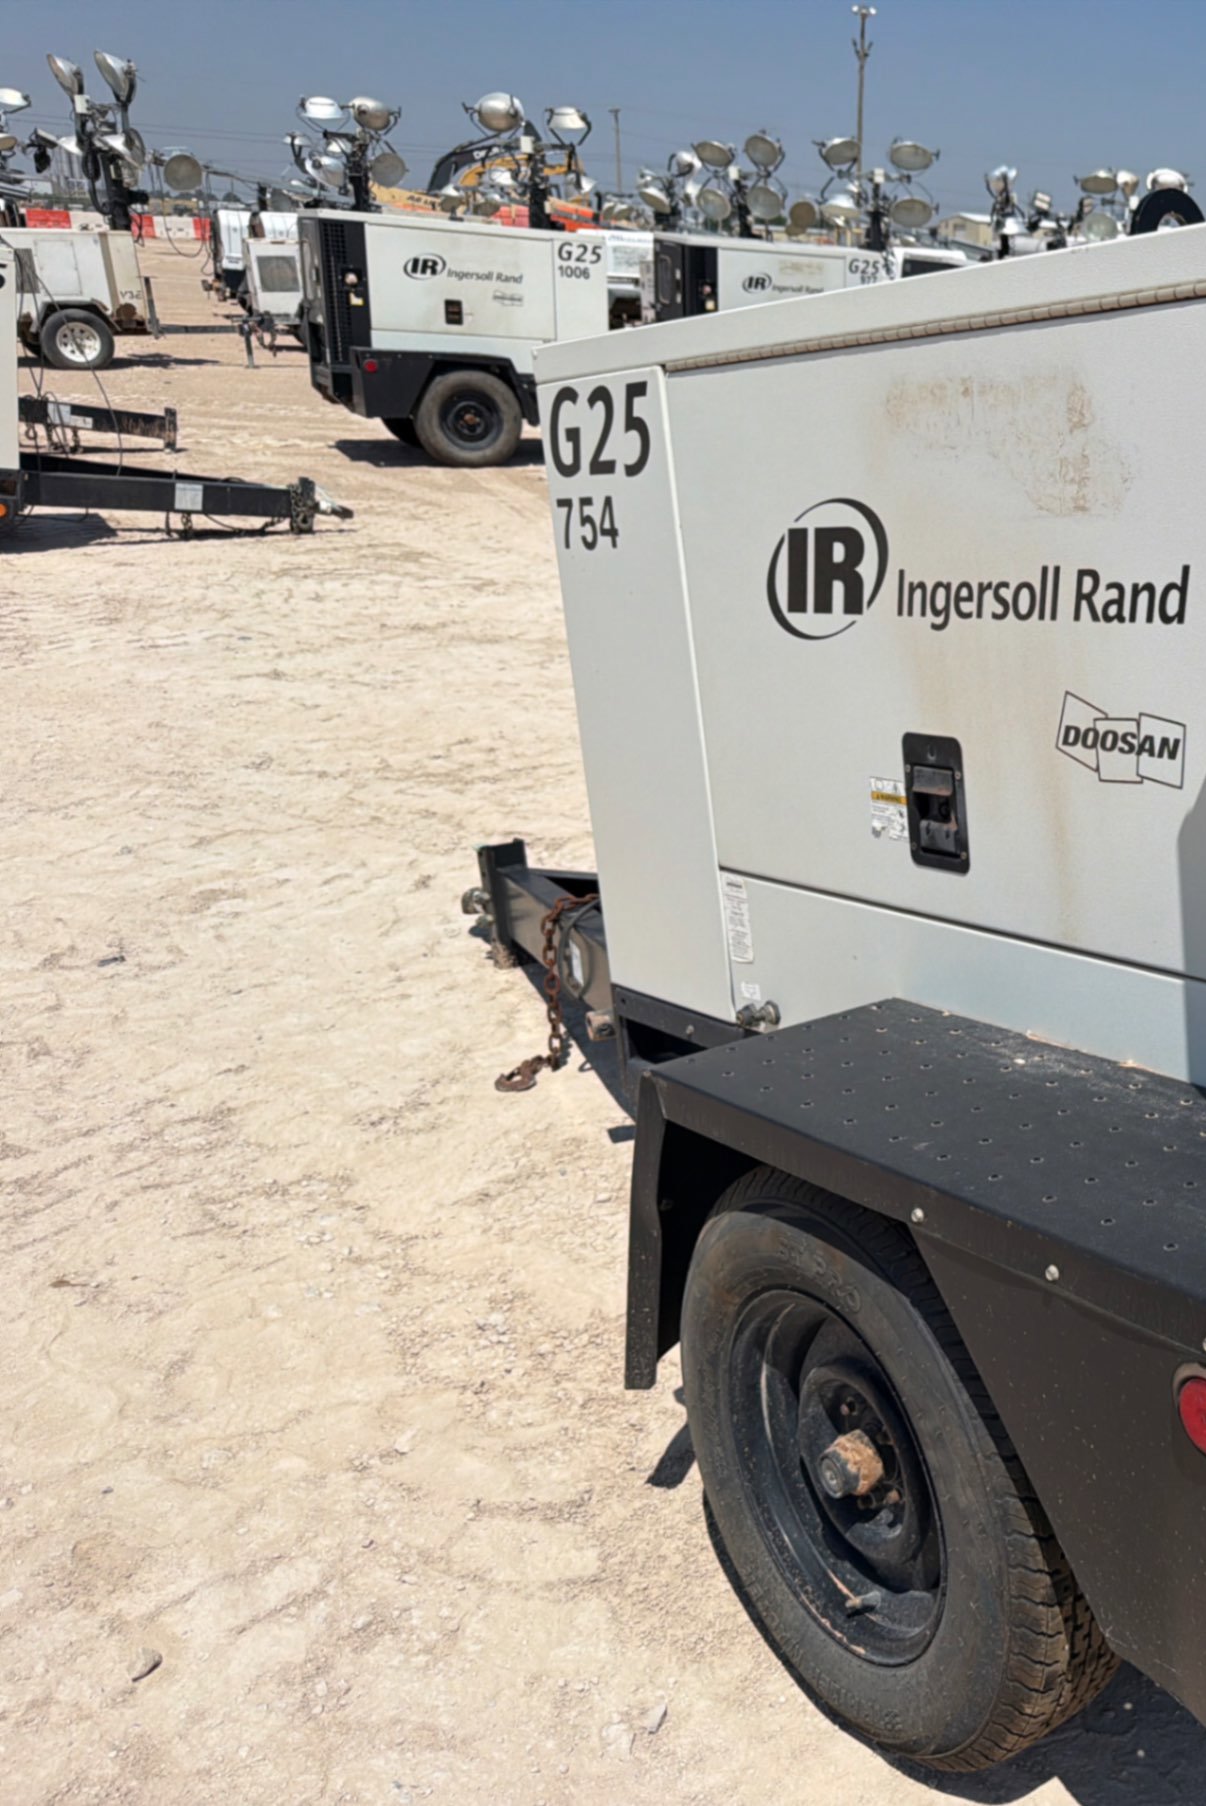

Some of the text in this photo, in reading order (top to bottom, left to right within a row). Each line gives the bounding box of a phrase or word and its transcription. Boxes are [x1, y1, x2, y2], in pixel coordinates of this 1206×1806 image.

[557, 241, 603, 265] G25
[849, 258, 880, 276] G25
[410, 257, 523, 284] IR Ingersoll Rand
[557, 265, 591, 280] 1006
[550, 380, 650, 479] G25
[556, 495, 619, 551] 754
[787, 525, 1191, 632] IR Ingersoll Rand
[1062, 724, 1181, 761] DOOSAN
